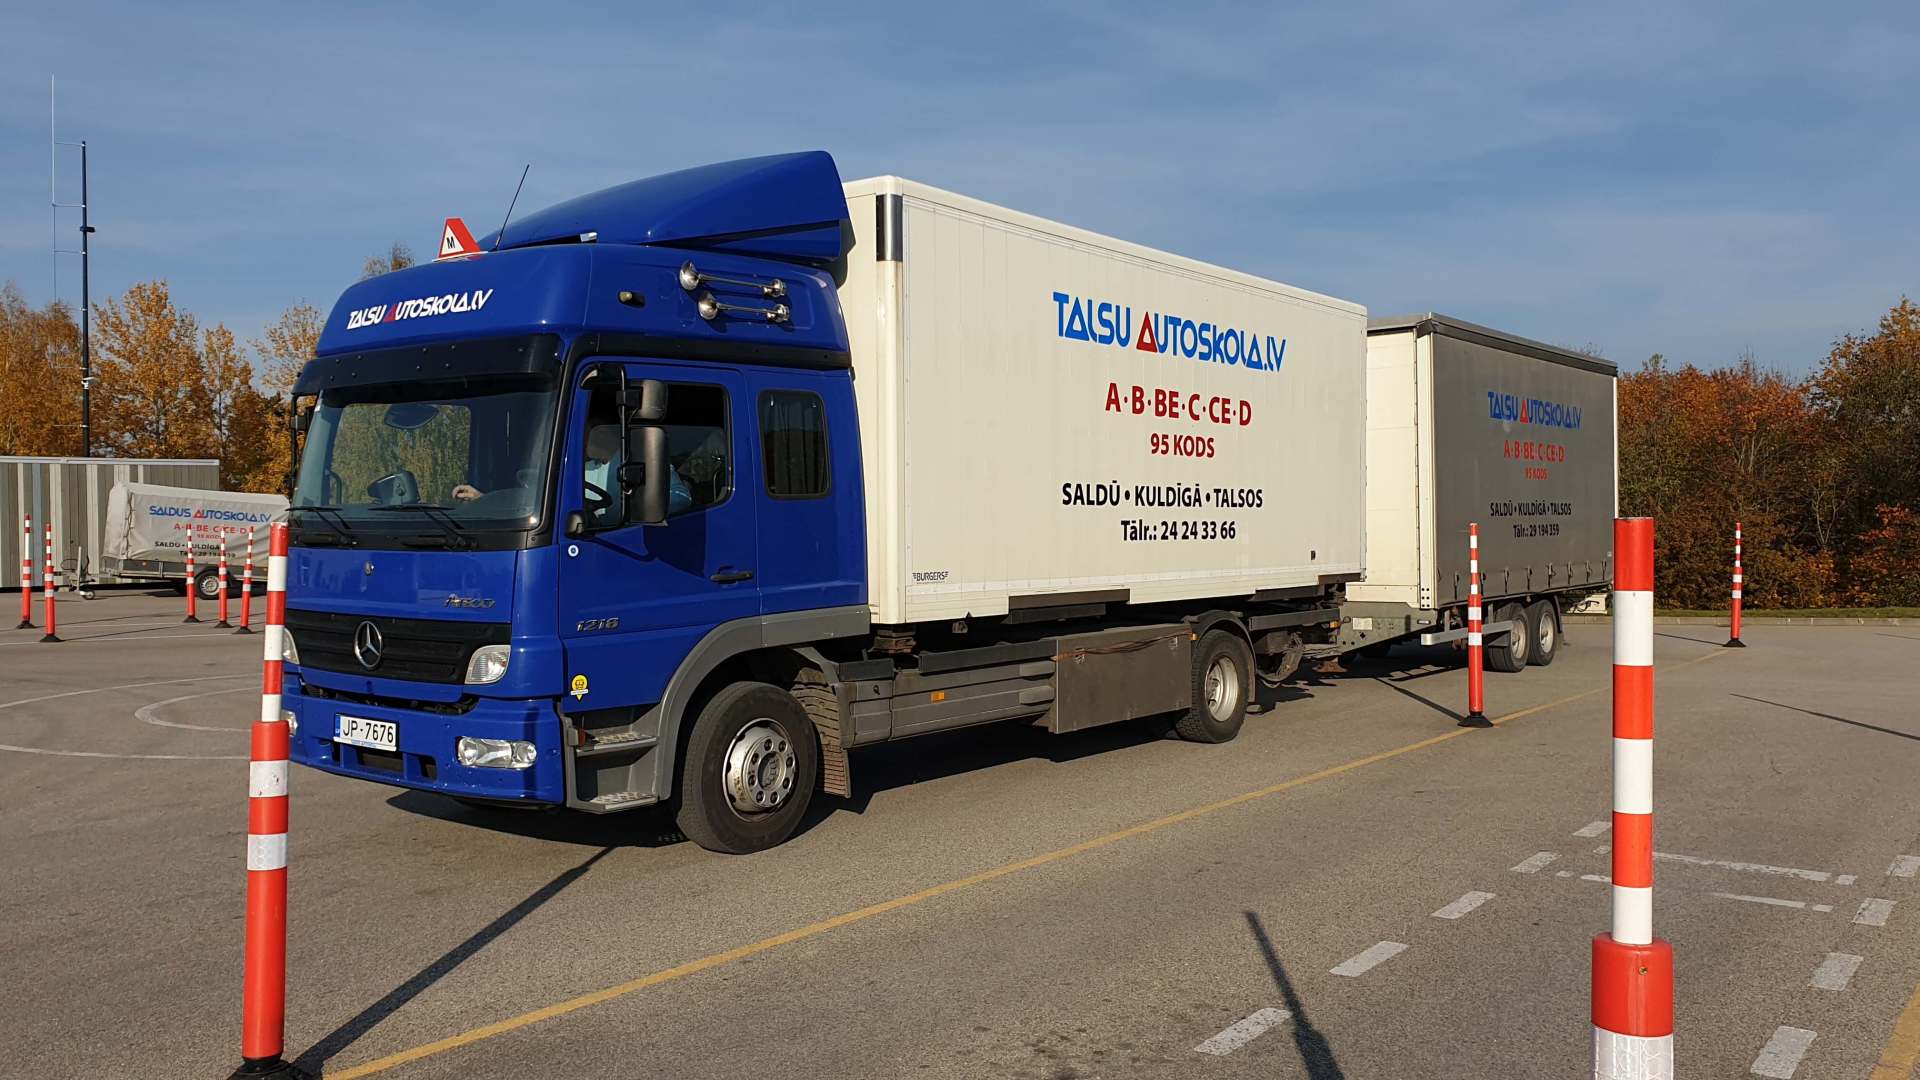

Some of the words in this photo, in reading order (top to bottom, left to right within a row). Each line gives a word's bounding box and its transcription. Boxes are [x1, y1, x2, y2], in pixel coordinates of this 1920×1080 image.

[446, 236, 456, 249] M
[347, 304, 387, 330] TALSU
[1053, 291, 1131, 348] TALSU
[1487, 391, 1519, 422] TALSU
[1150, 433, 1170, 455] 95
[1173, 434, 1215, 458] KODS
[1062, 480, 1121, 506] SALDŪ
[1135, 482, 1203, 507] KULDĪGĀ
[1213, 488, 1263, 508] TALSOS
[150, 505, 191, 518] SALDUS
[1550, 502, 1572, 516] TALSOS
[1121, 519, 1157, 541] Tālr.:
[1160, 520, 1178, 541] 24
[1181, 520, 1199, 540] 24
[1201, 520, 1217, 540] 33
[1220, 520, 1236, 540] 66
[915, 571, 946, 581] BURGERS
[576, 617, 620, 632] 1216
[342, 719, 394, 743] JP-7676
